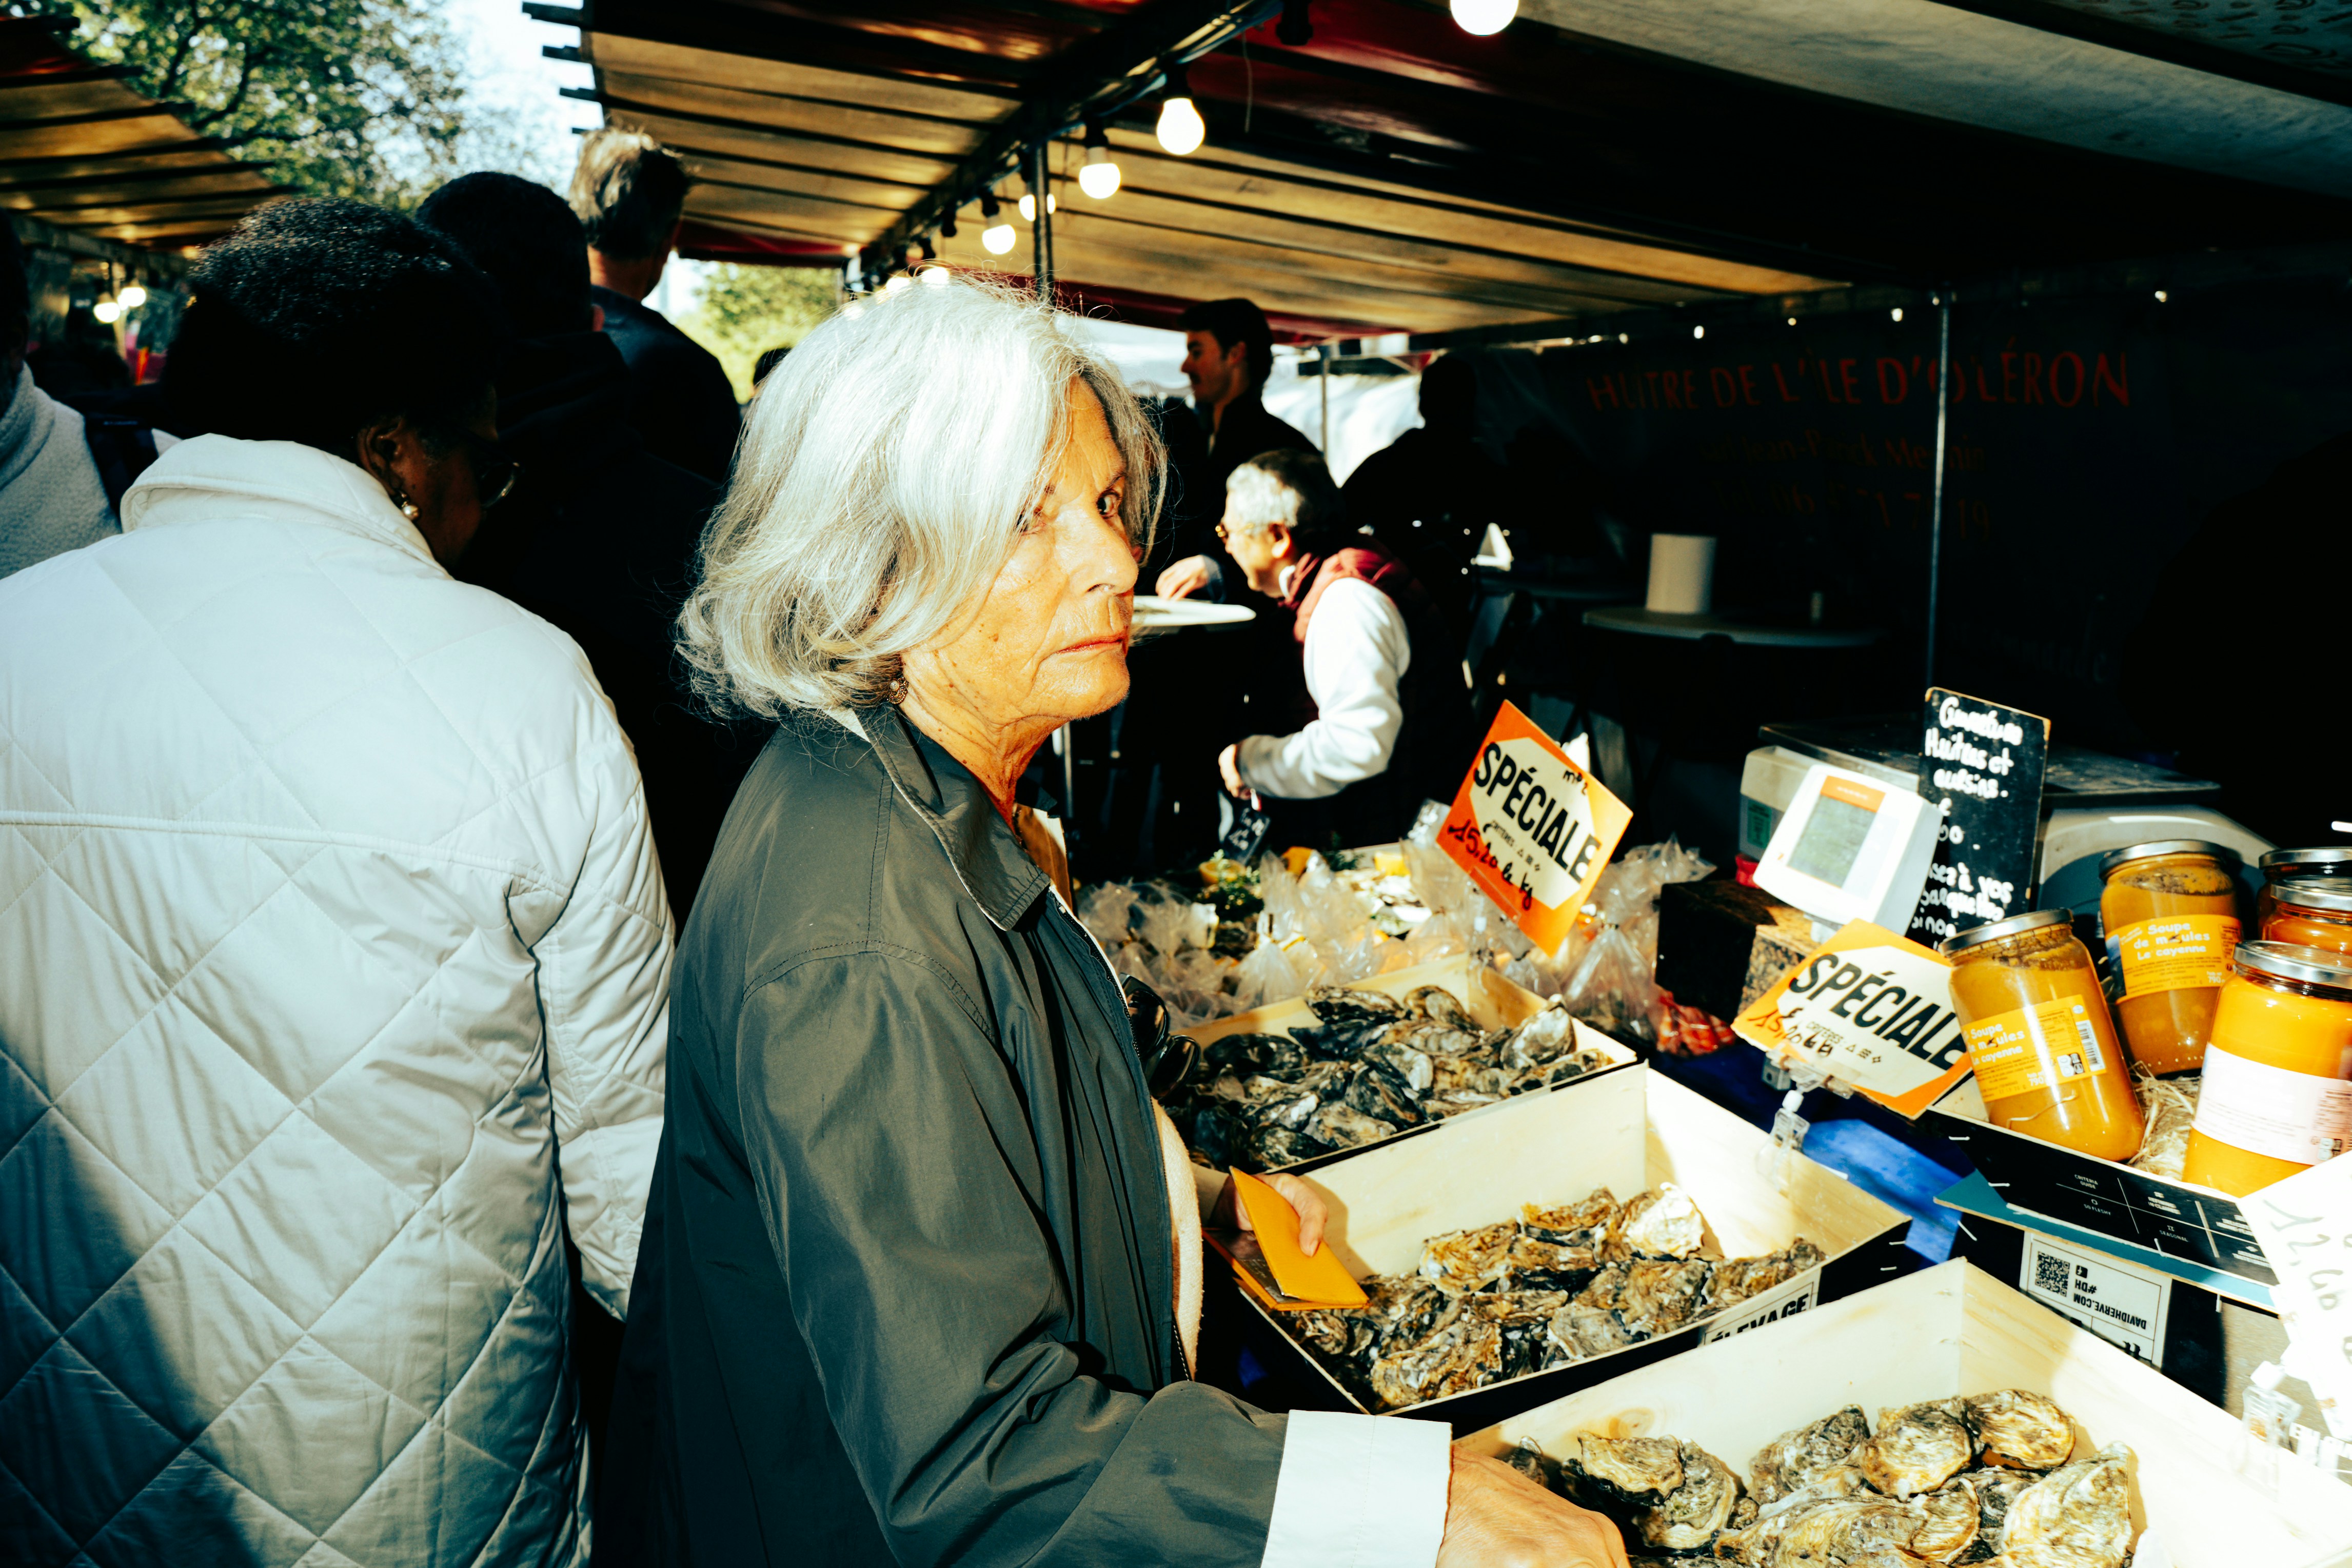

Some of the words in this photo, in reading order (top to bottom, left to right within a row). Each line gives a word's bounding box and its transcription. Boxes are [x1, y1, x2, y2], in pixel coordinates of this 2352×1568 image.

[1709, 363, 1762, 409] DE
[1874, 333, 2131, 409] D'OLÉRON
[1988, 747, 2014, 776] et
[1473, 742, 1602, 883] SPÉCIALE
[1978, 876, 2014, 904] vos
[2148, 923, 2190, 935] Soupe
[2133, 939, 2149, 949] de
[2137, 950, 2151, 961] Le
[2156, 946, 2206, 957] cayenne
[1789, 954, 1967, 1071] SPÉCIALE
[1970, 1023, 2003, 1039] Soupe
[1981, 1045, 2023, 1063] cayenne
[2074, 1174, 2098, 1185] CRITERIA
[2080, 1181, 2096, 1189] GUIDE
[2159, 1230, 2189, 1242] SEASONAL
[2075, 1279, 2097, 1294] #DH
[1711, 1293, 1808, 1342] VAGE
[2073, 1293, 2147, 1330] DAVIDHERVE.COM
